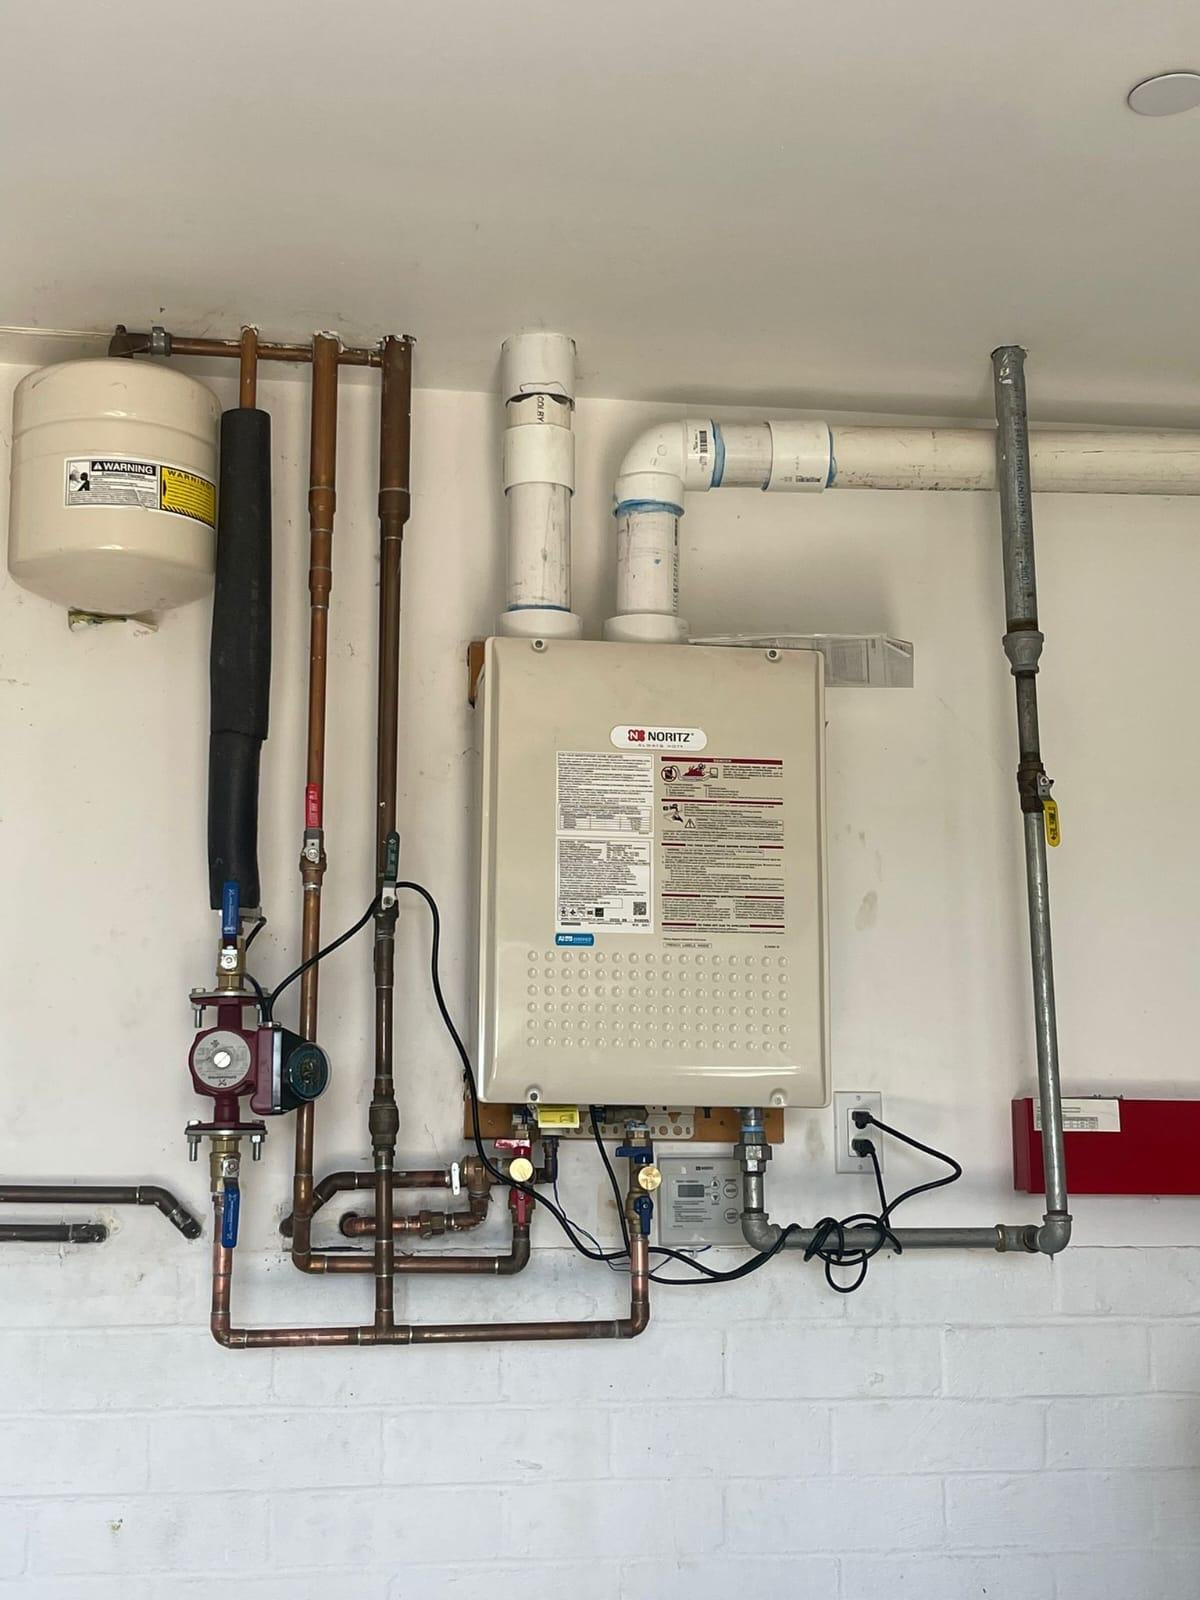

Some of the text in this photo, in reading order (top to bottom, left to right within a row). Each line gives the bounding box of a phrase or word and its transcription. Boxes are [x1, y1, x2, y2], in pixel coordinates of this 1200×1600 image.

[103, 462, 153, 474] WARNING
[167, 469, 213, 489] WARNING
[648, 731, 691, 742] NORITZ
